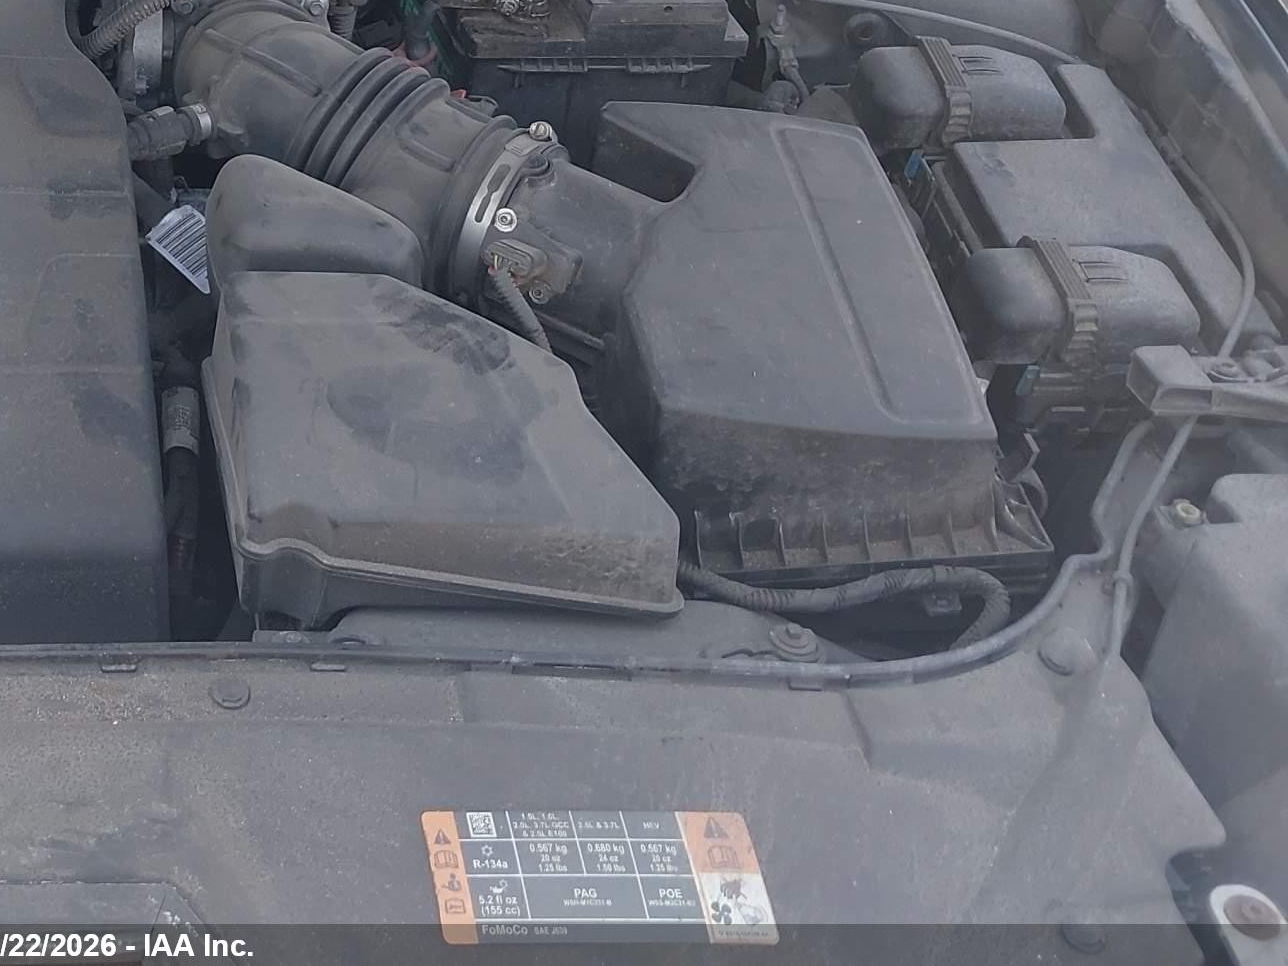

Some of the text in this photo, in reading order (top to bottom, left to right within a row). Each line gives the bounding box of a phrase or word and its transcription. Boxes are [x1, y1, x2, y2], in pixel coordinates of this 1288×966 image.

[529, 843, 568, 855] 0.567 kg
[613, 843, 625, 856] kg
[665, 844, 677, 856] kg
[472, 859, 509, 870] R-134a
[573, 887, 598, 899] PAG
[658, 888, 683, 899] POE
[478, 895, 518, 905] 5.2 fl oz
[481, 905, 521, 917] (155 cc)
[481, 924, 529, 936] FoMoCo
